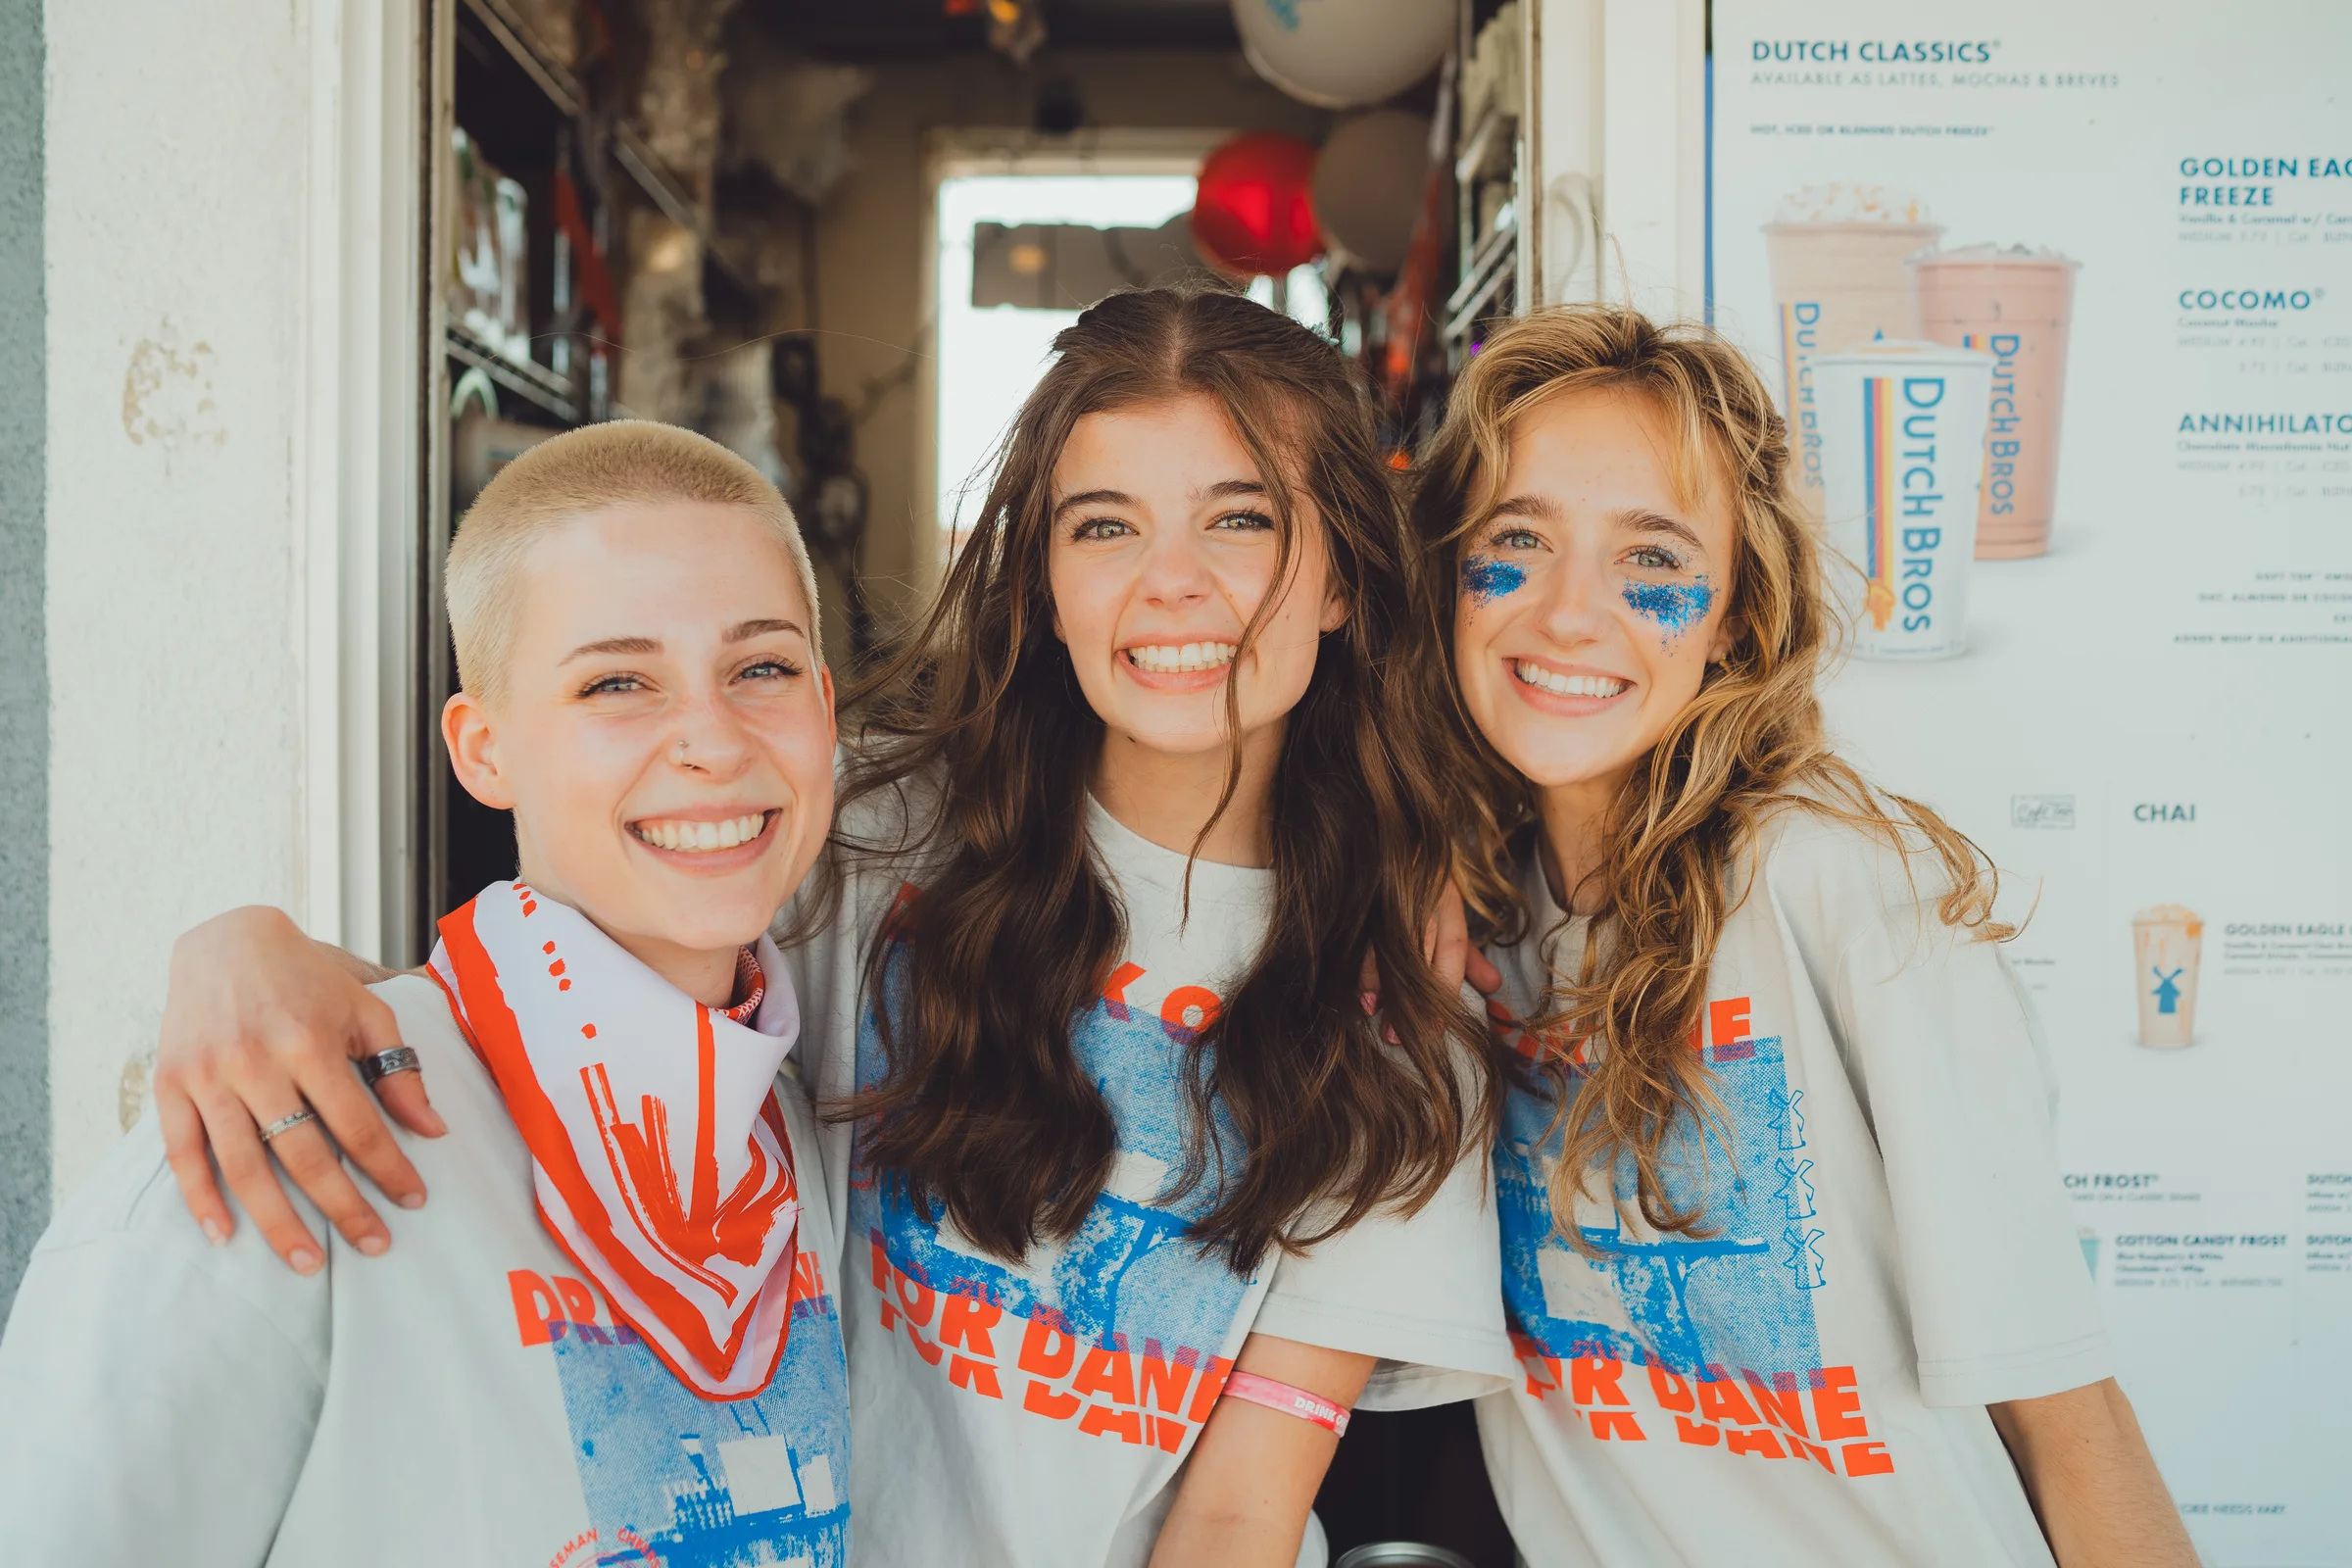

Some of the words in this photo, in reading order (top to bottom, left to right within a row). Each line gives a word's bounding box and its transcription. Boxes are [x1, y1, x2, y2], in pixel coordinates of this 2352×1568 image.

[1752, 40, 1848, 62] DUTCH
[1751, 73, 1841, 86] AVAILABLE
[1849, 73, 1872, 86] AS
[1952, 74, 2031, 87] MOCHAS
[2055, 74, 2120, 87] BREVES
[2180, 158, 2297, 177] GOLDEN
[2180, 186, 2274, 206] FREEZE
[1989, 334, 2021, 432] DUTCH
[1902, 377, 1945, 516] DUTCH
[1989, 440, 2021, 515] BROS
[1902, 527, 1941, 632] BROS
[2133, 804, 2196, 822] CHAI
[2224, 923, 2292, 936] GOLDEN
[2296, 923, 2345, 936] EAGLE
[2063, 1173, 2087, 1189] CH
[2115, 1235, 2179, 1247] COTTON
[2183, 1235, 2235, 1247] CANDY
[2239, 1235, 2287, 1247] FROST
[1642, 1348, 1868, 1442] DANE
[1294, 1396, 1337, 1423] DRINK
